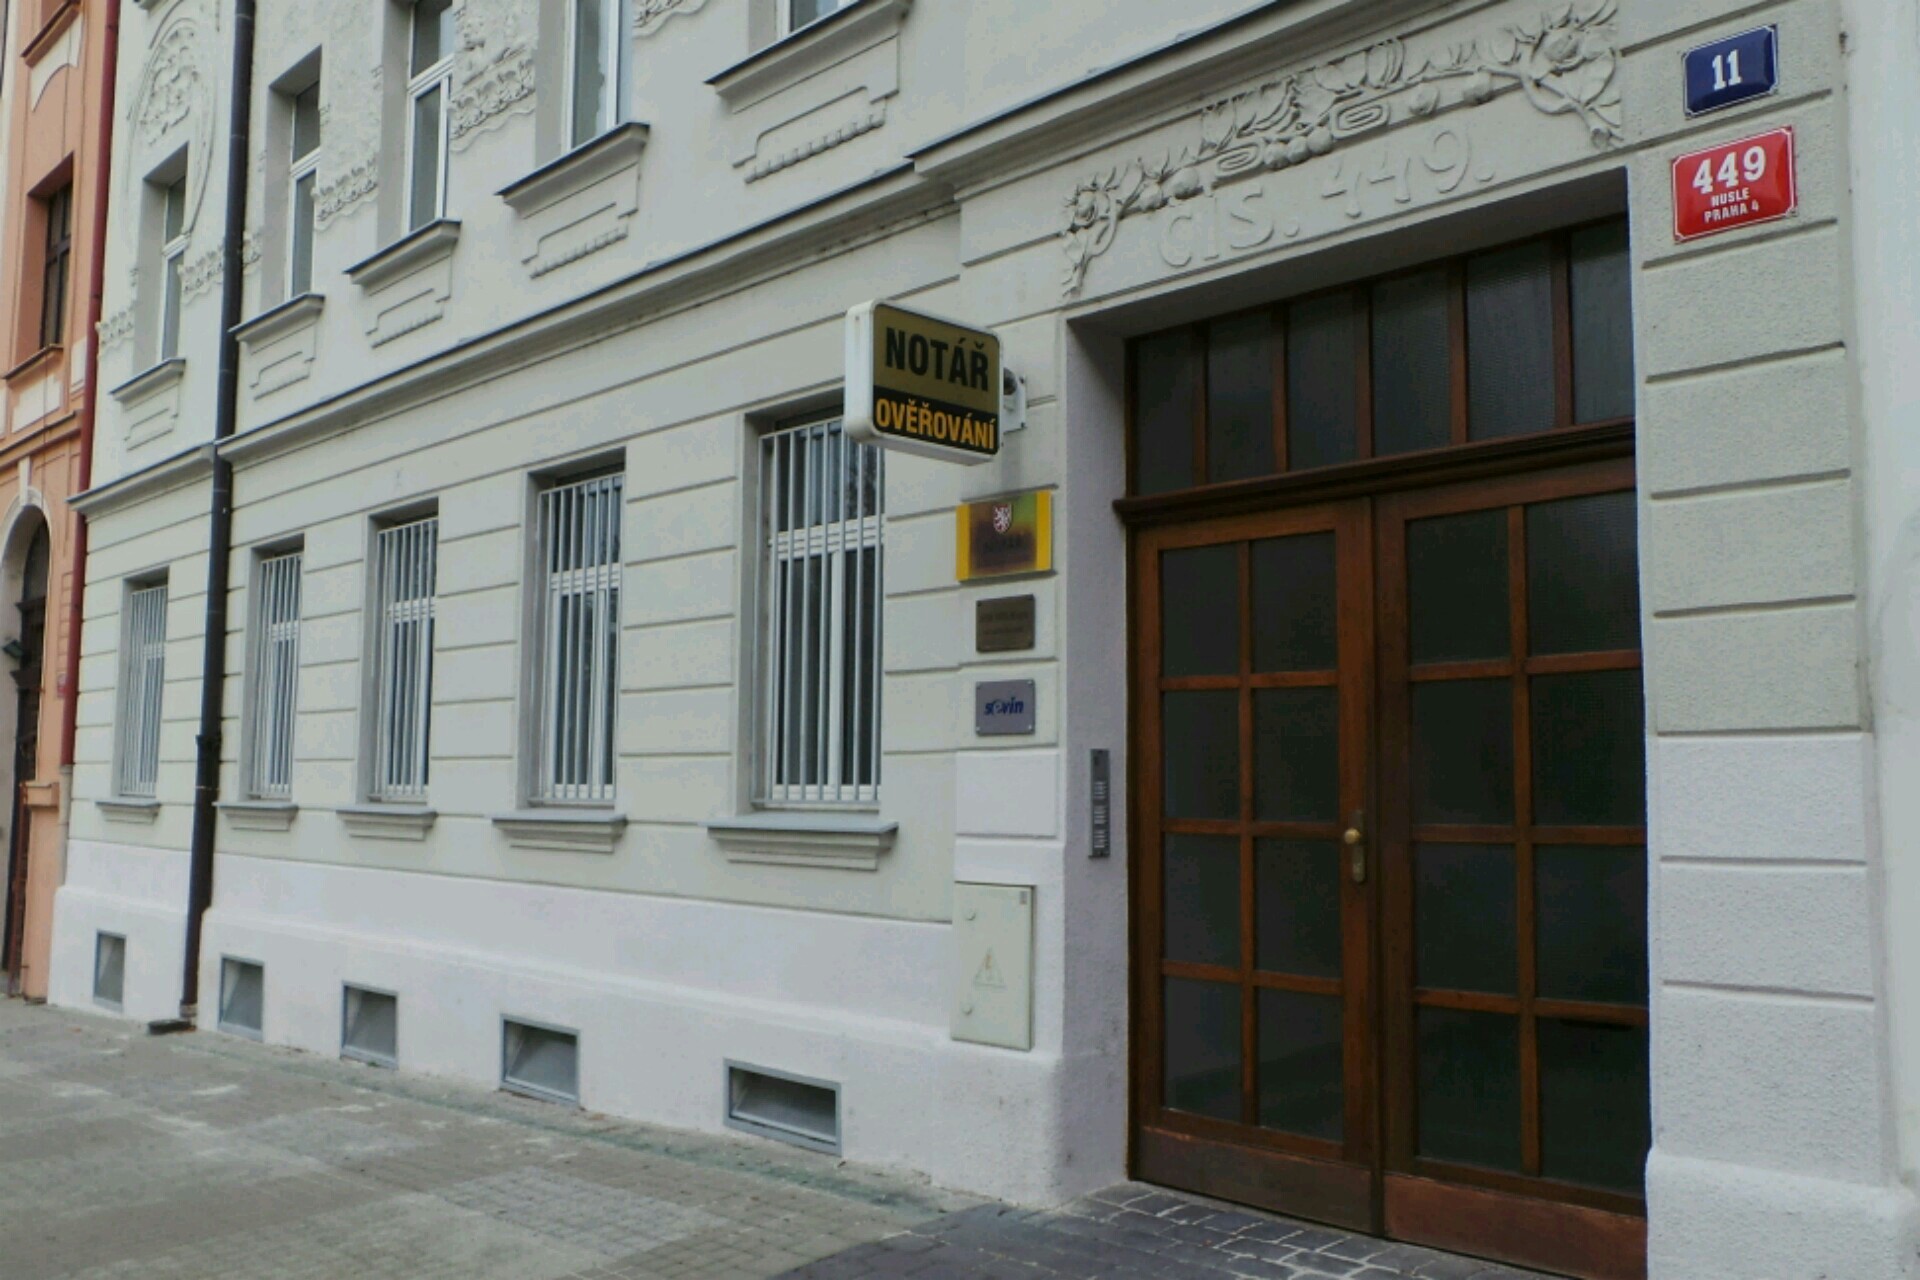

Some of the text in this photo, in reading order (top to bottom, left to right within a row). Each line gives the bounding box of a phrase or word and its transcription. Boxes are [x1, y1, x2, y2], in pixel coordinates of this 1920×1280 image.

[1711, 48, 1744, 91] 11
[1692, 144, 1767, 195] 449
[1703, 200, 1760, 223] PRAHA 4
[1710, 186, 1751, 207] NUSLE
[885, 326, 989, 392] NOTÁŘ
[875, 397, 997, 450] OVĚŘOVÁNÍ
